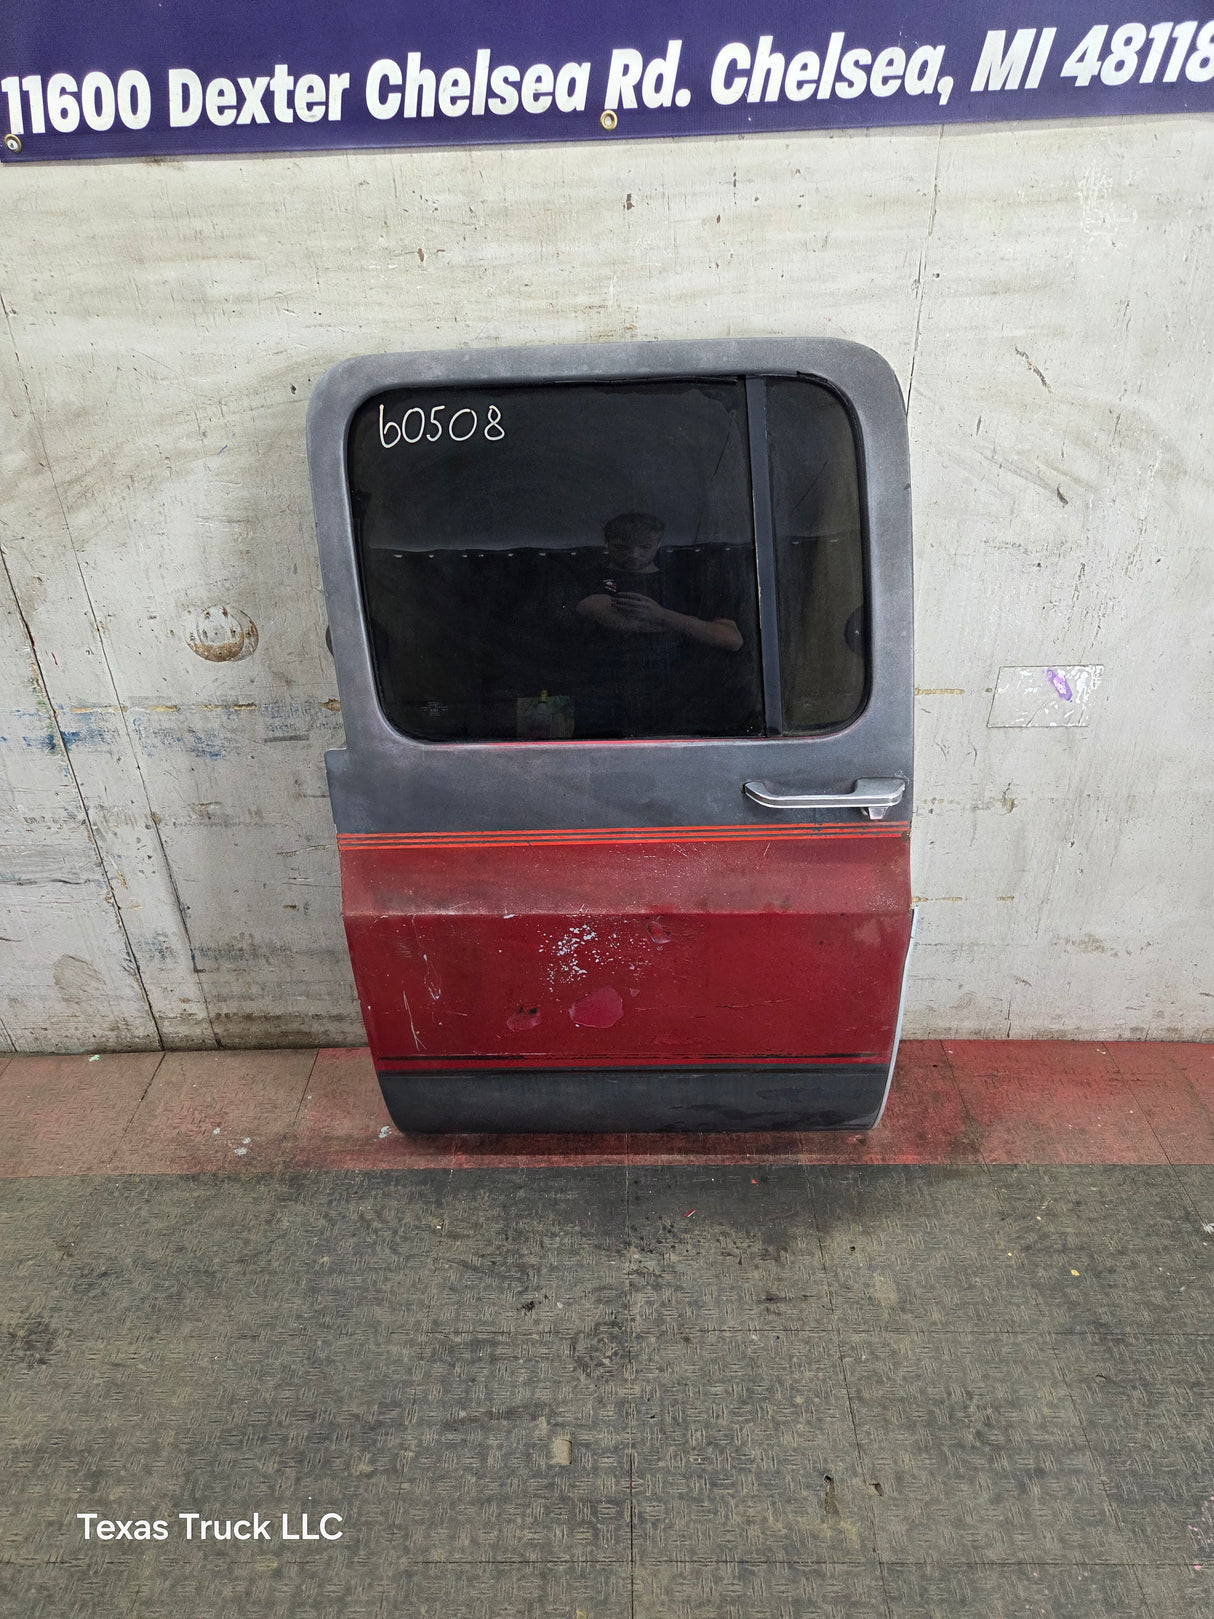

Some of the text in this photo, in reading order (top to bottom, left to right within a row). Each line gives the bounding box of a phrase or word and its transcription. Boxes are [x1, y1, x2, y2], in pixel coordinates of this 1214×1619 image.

[1, 20, 1214, 134] 11600 Dexter Chelsea Rd. Chelsea, MI 48118
[379, 404, 505, 449] 60508
